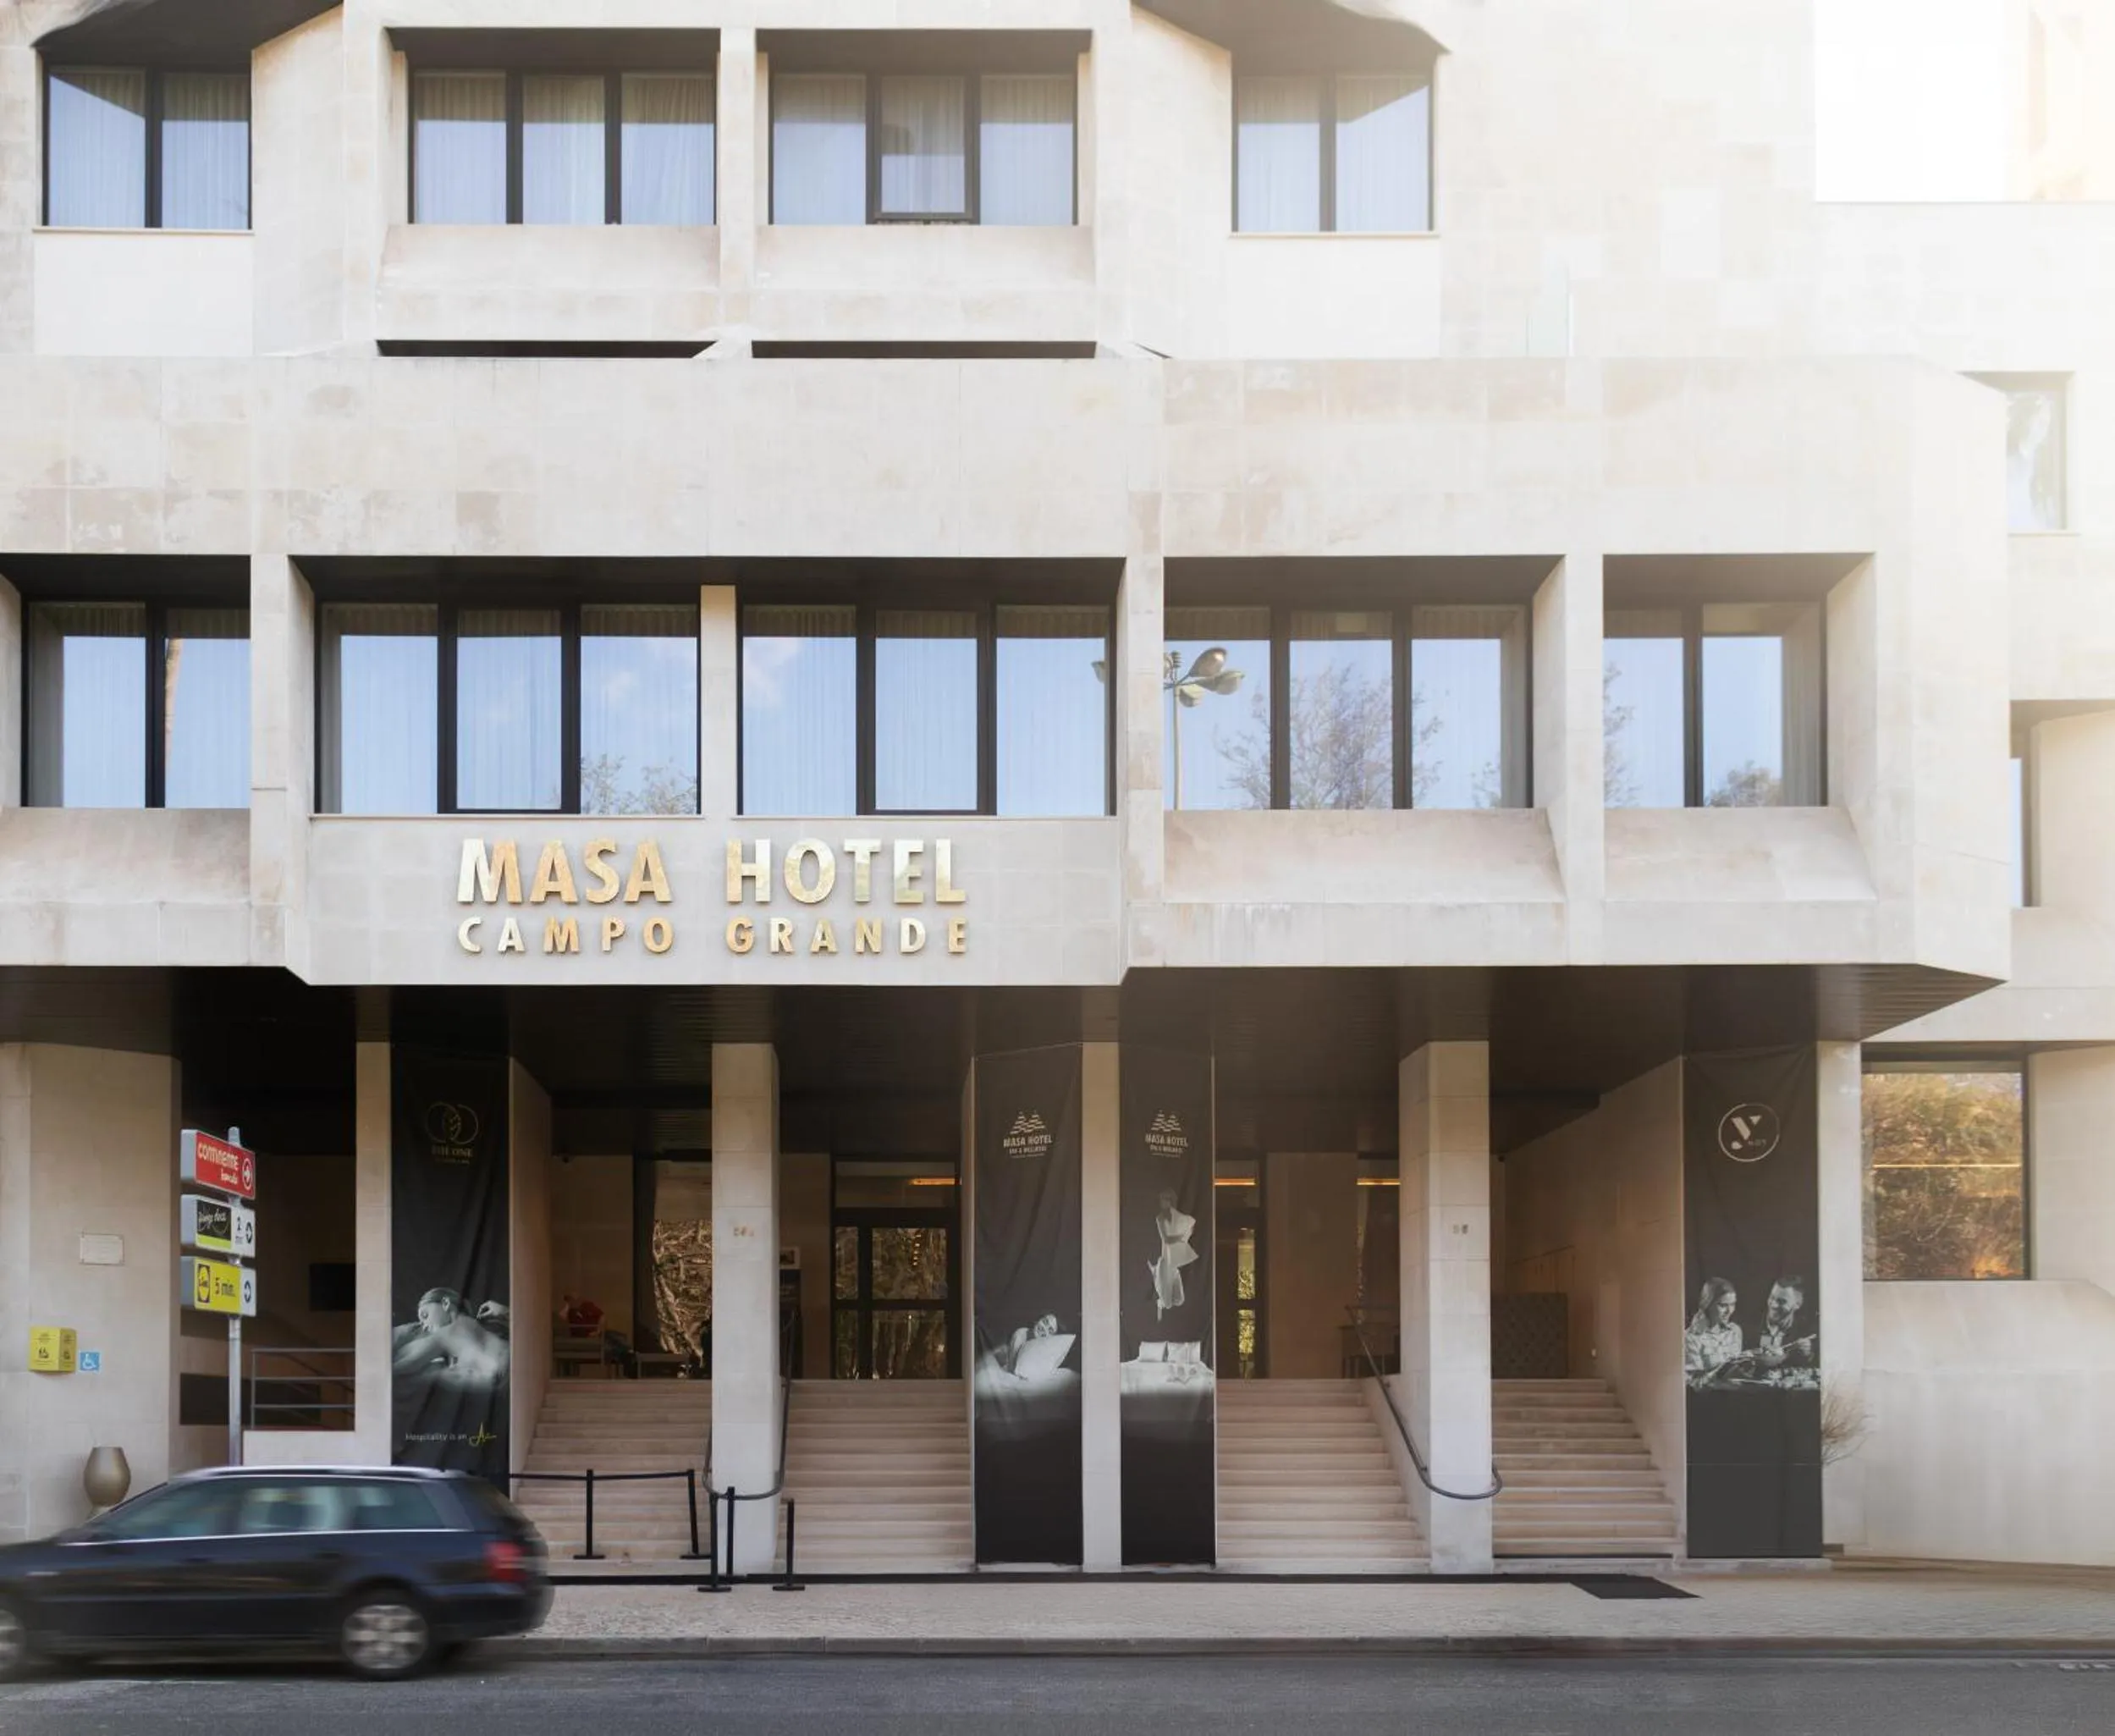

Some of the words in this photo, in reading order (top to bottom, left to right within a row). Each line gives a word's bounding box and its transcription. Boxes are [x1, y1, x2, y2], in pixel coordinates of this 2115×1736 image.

[457, 838, 673, 903] MASA
[725, 838, 967, 903] HOTEL
[457, 917, 674, 953] CAMPO
[725, 917, 969, 953] GRANDE
[1003, 1137, 1026, 1149] MASA
[1027, 1134, 1053, 1145] HOTEL
[1145, 1133, 1165, 1144] MASA
[1166, 1136, 1188, 1148] HOTEL
[215, 1277, 220, 1295] 5
